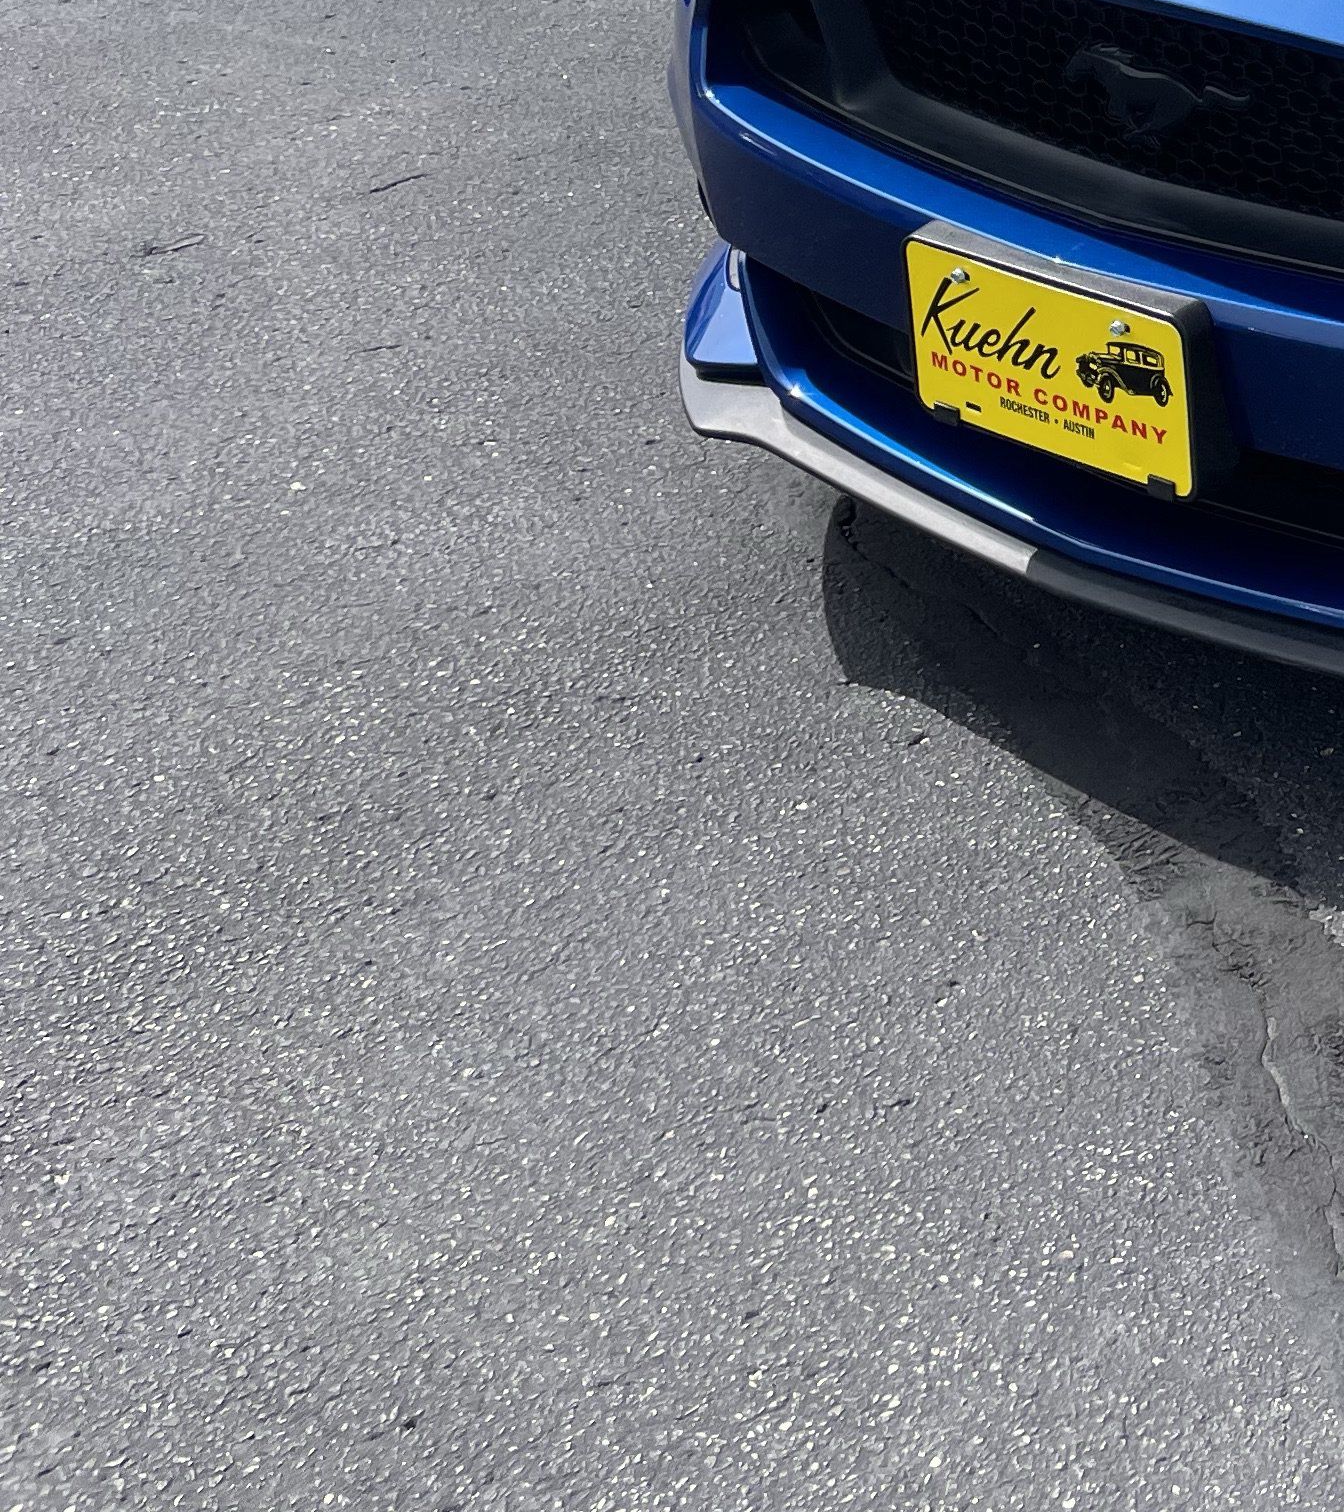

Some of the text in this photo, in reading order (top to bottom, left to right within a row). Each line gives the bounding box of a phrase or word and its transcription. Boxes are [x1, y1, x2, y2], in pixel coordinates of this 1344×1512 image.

[920, 276, 1062, 381] Kuehn
[930, 351, 1169, 446] MOTOR COMPANY
[999, 396, 1096, 440] ROCHESTER AUSTIN
